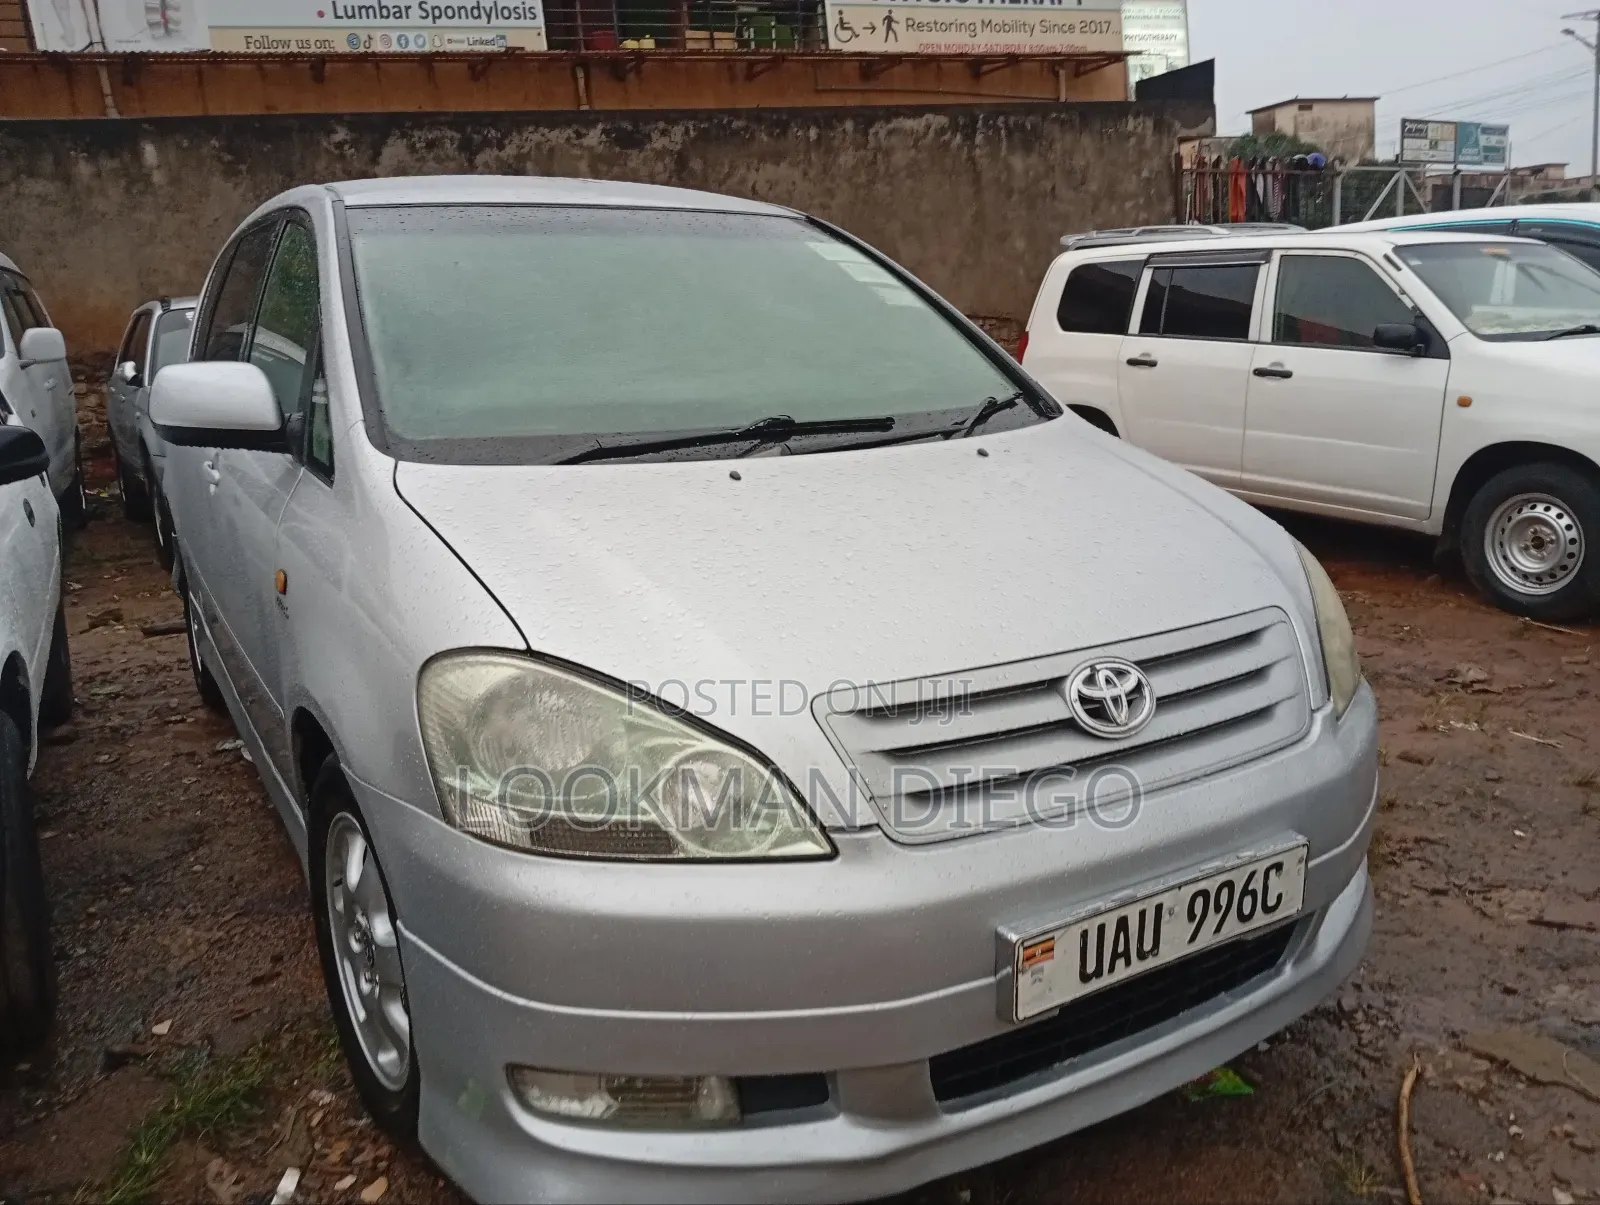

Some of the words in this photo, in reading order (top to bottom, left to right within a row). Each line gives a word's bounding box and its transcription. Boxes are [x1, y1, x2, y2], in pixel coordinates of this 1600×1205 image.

[332, 0, 412, 20] Lumbar
[418, 1, 538, 25] Spondylosis
[905, 17, 978, 38] Restoring
[981, 19, 1036, 37] Mobility
[1040, 20, 1076, 34] Since
[244, 35, 293, 50] Follow
[296, 39, 312, 50] us
[1124, 33, 1178, 41] PHYSIOTHERAPY
[918, 43, 942, 53] OPEN
[1078, 901, 1164, 984] UAU
[1186, 861, 1285, 945] 996C
